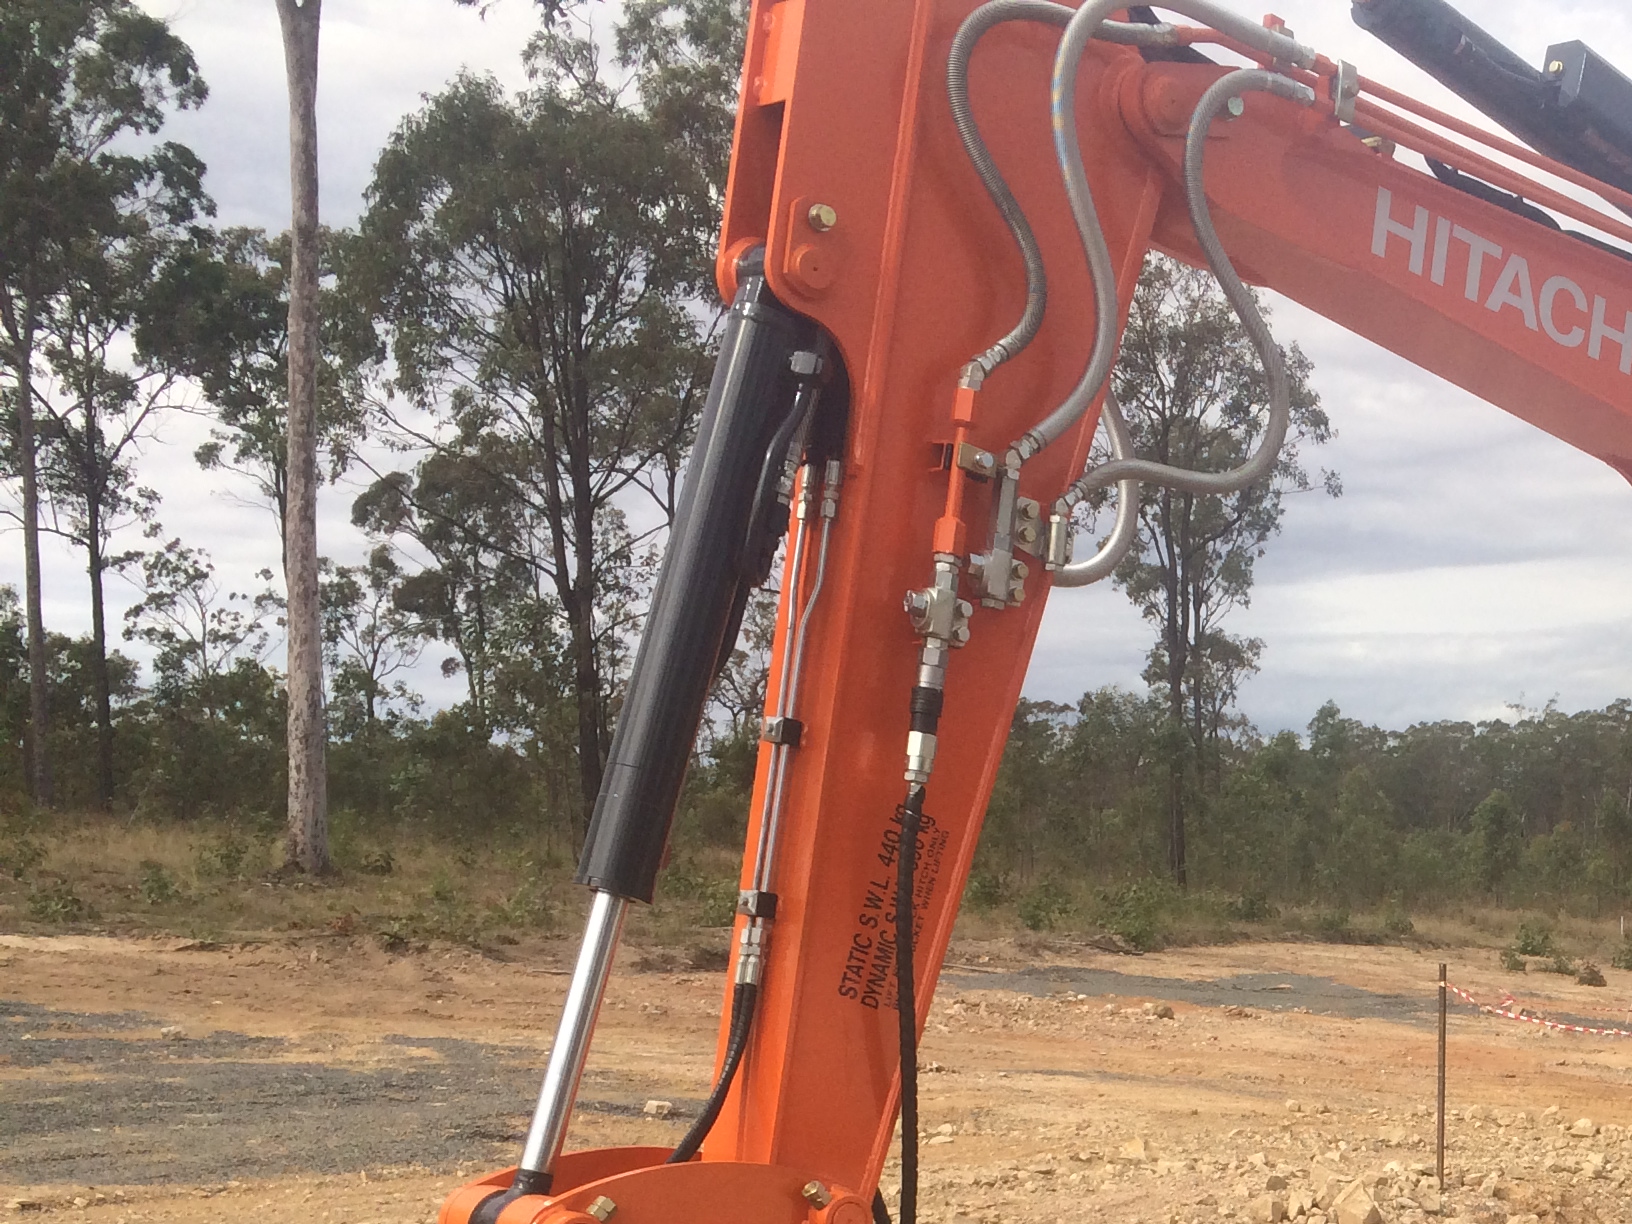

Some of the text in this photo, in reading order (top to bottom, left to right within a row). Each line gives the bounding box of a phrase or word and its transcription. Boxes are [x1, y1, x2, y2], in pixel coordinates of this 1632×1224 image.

[915, 862, 933, 898] HITCH
[927, 827, 941, 858] ONLY
[923, 877, 937, 910] WHEN
[931, 830, 950, 874] LIFTING
[838, 933, 873, 1000] STATIC
[859, 876, 891, 930] S.W.L.
[877, 829, 901, 868] 440
[860, 929, 898, 1010] DYNAMIC
